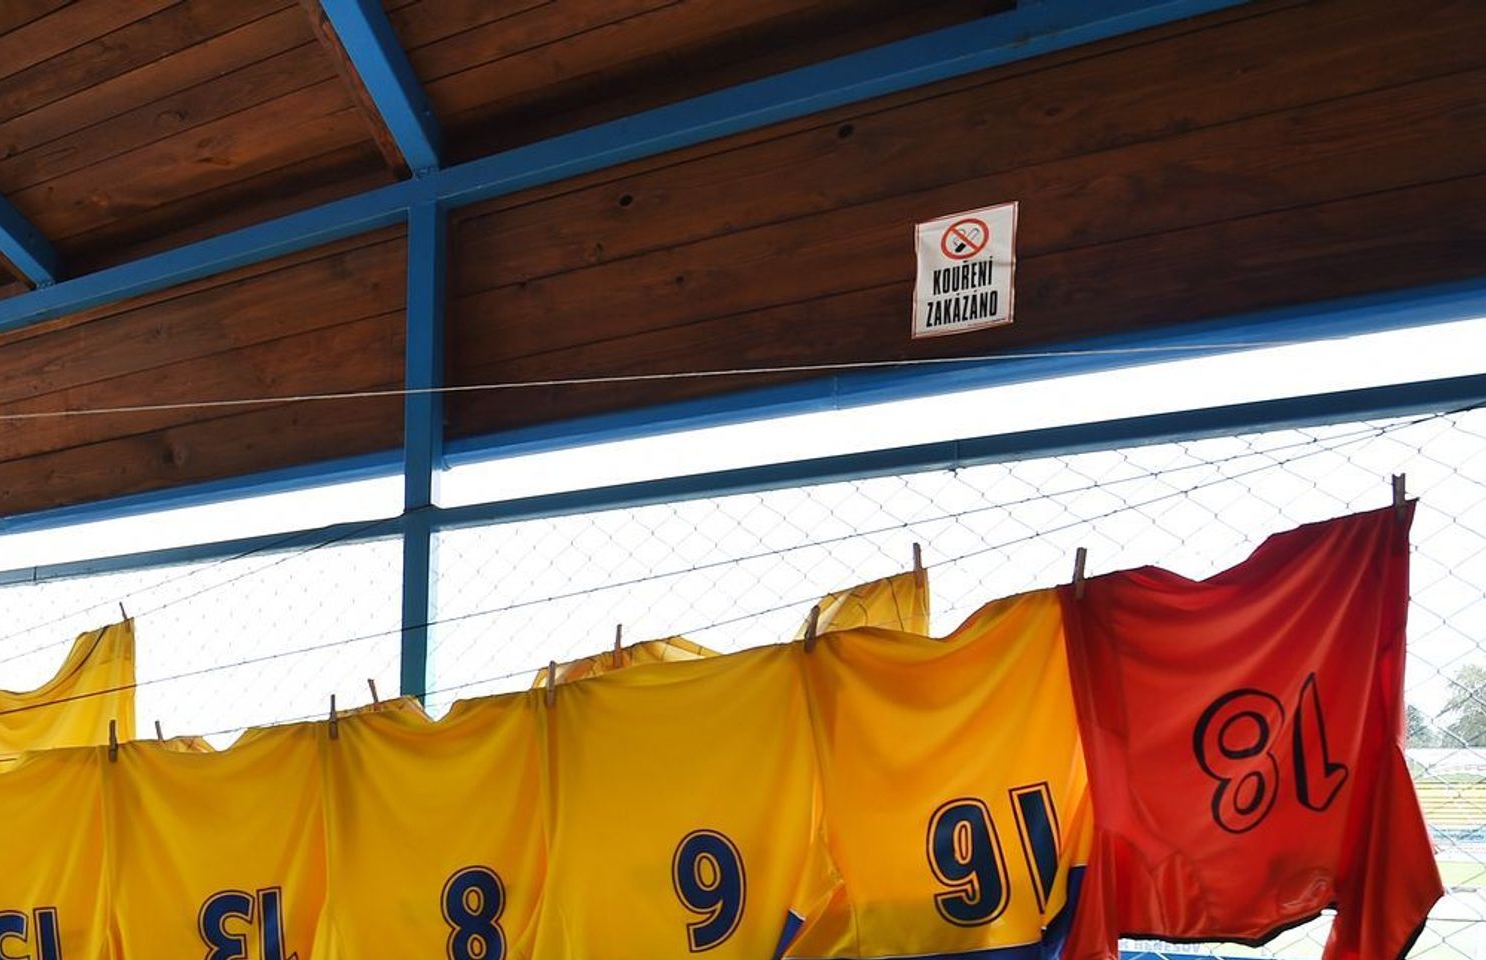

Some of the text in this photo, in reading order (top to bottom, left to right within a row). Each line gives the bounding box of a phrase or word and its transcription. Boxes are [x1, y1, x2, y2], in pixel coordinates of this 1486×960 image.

[926, 290, 998, 328] ZAKÁZÁNO
[933, 256, 993, 296] KOUŘENÍ
[1192, 672, 1349, 834] 18
[671, 829, 746, 953] 6
[926, 781, 1062, 927] 16
